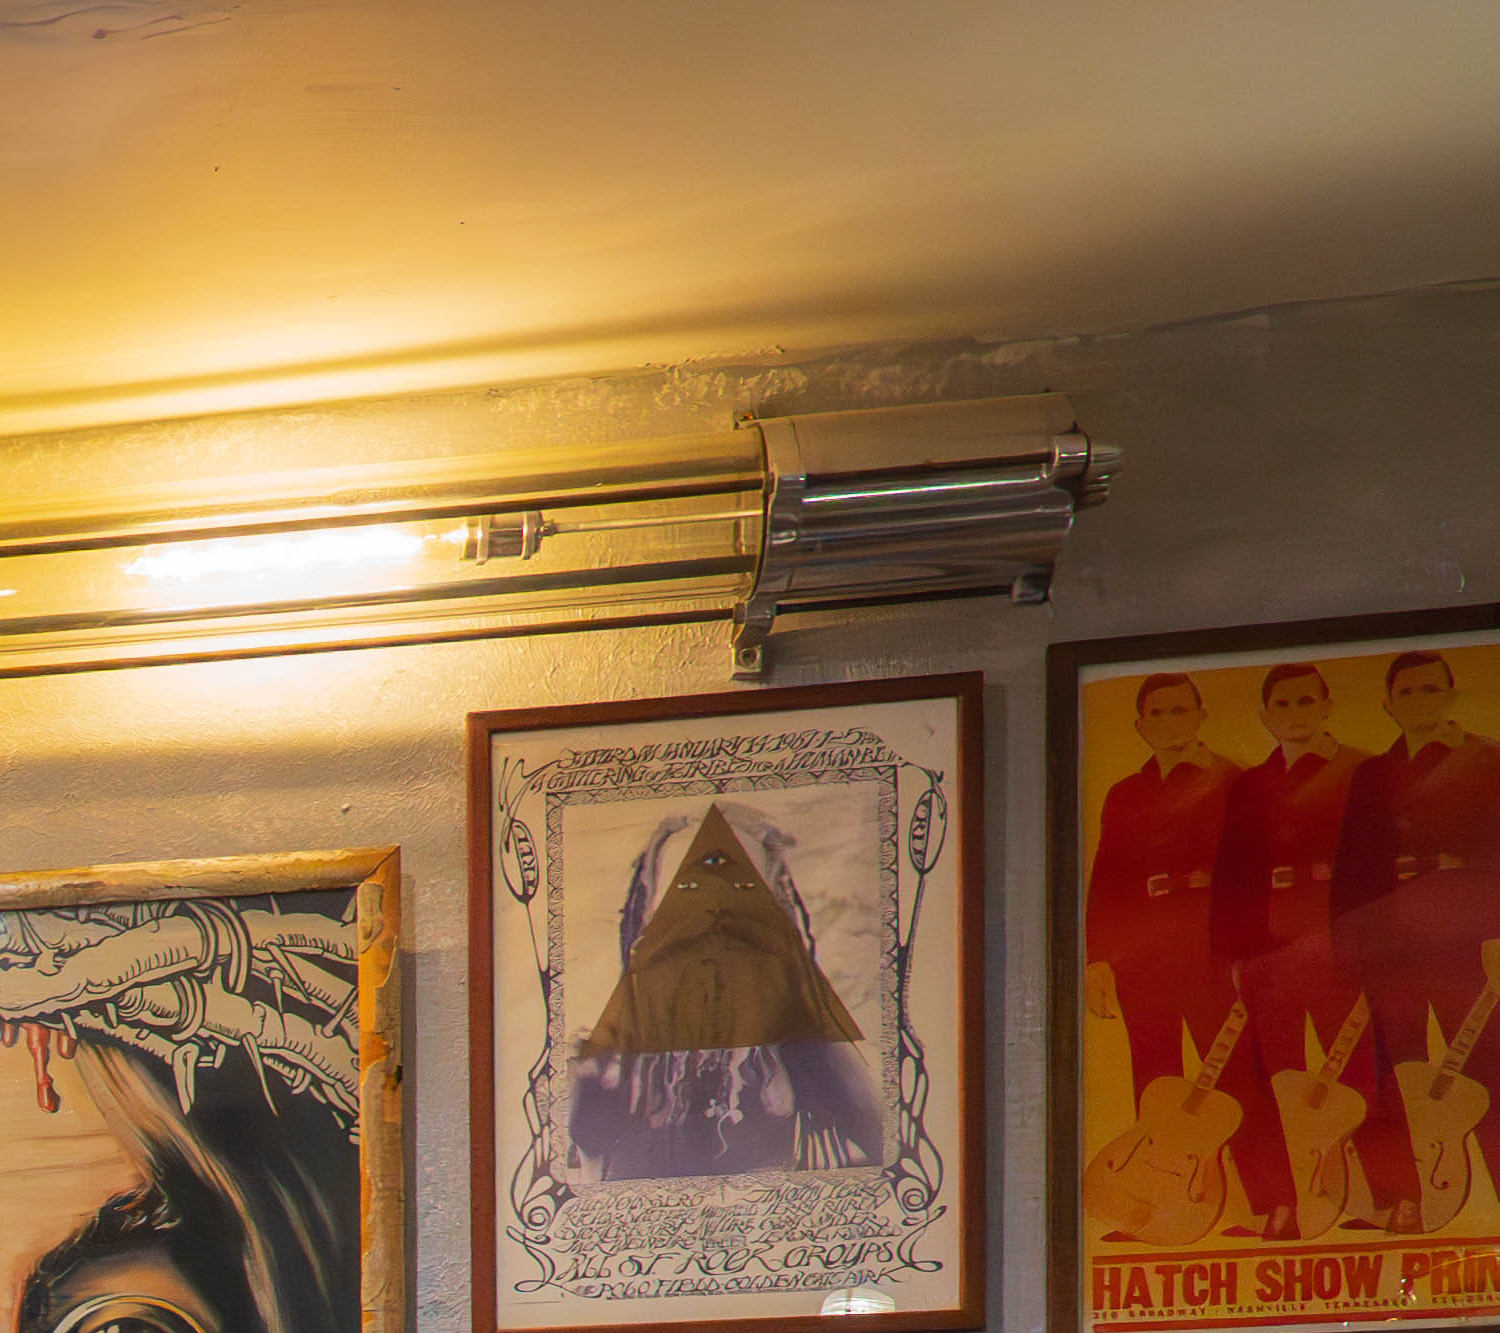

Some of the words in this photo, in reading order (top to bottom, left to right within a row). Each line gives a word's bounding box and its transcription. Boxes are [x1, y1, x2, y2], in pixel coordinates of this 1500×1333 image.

[555, 1253, 612, 1281] ALL
[784, 1239, 895, 1269] GROUPS
[1092, 1261, 1238, 1310] HATCH
[1255, 1254, 1384, 1303] SHOW
[1129, 1306, 1207, 1319] BROADWAY
[1227, 1302, 1307, 1315] NASHVILLE
